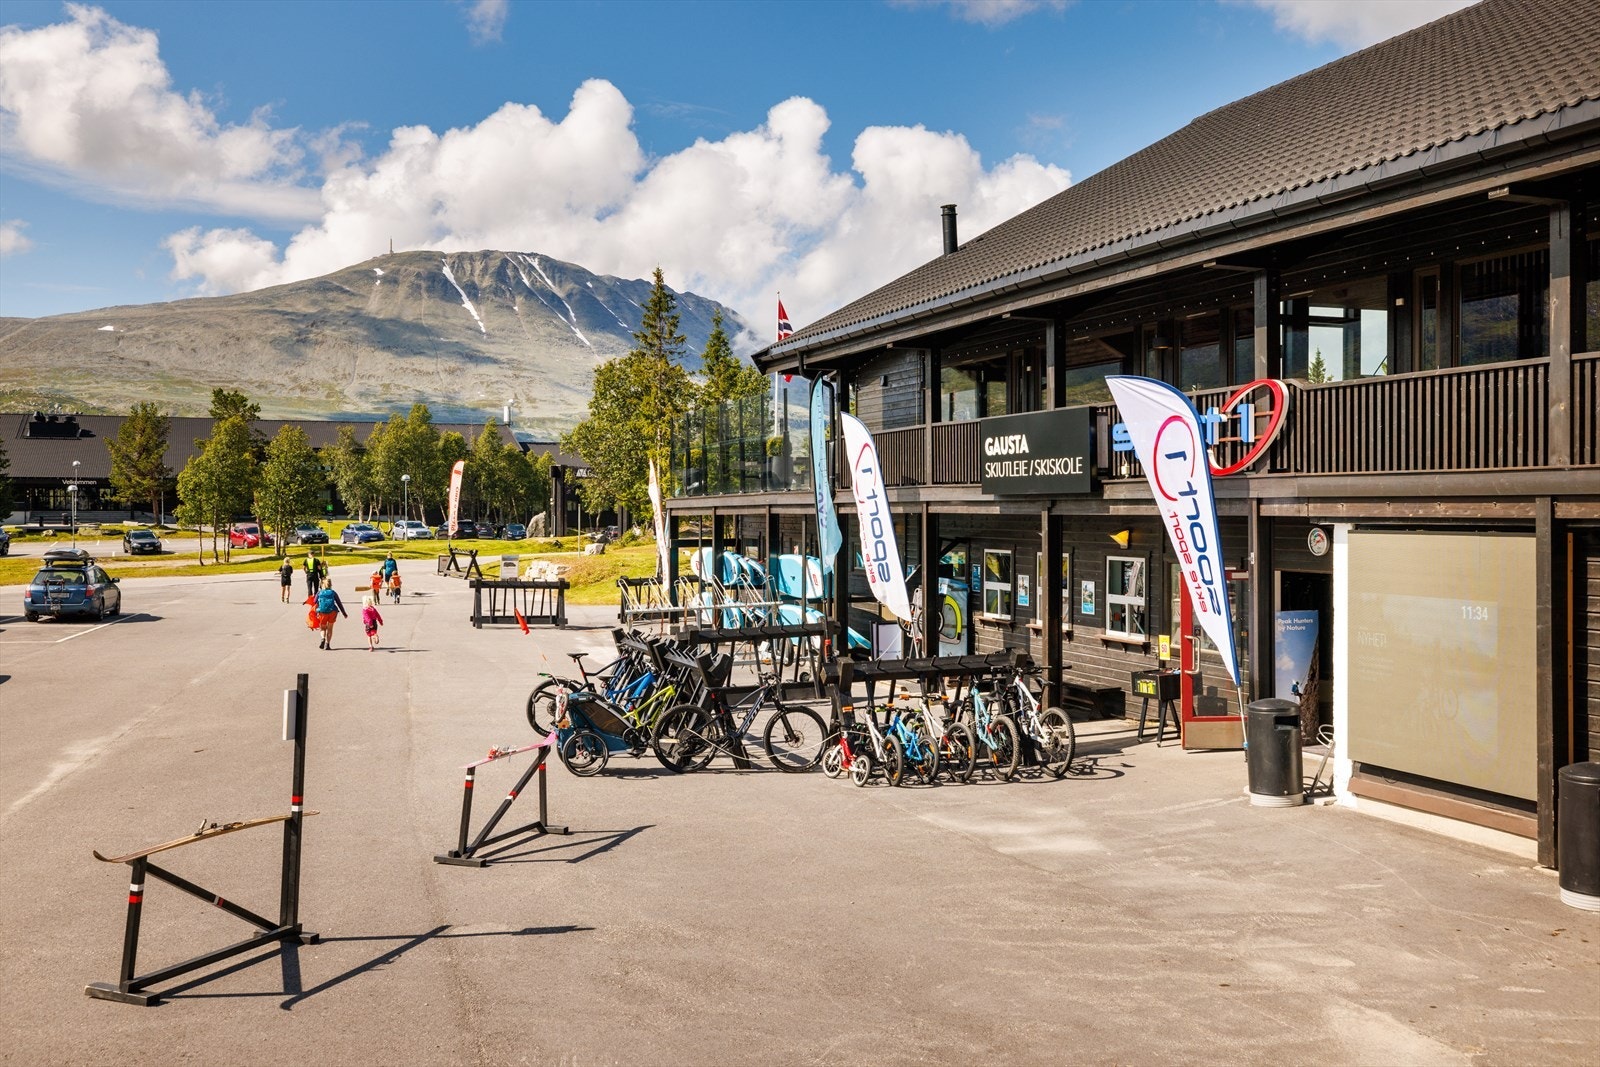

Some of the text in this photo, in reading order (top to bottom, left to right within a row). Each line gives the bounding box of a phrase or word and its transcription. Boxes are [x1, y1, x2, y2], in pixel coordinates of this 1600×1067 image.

[984, 434, 1030, 456] GAUSTA
[985, 460, 1028, 478] SKIUTLEIE
[1034, 457, 1083, 476] SKISKOLE
[1461, 605, 1489, 621] 11:34
